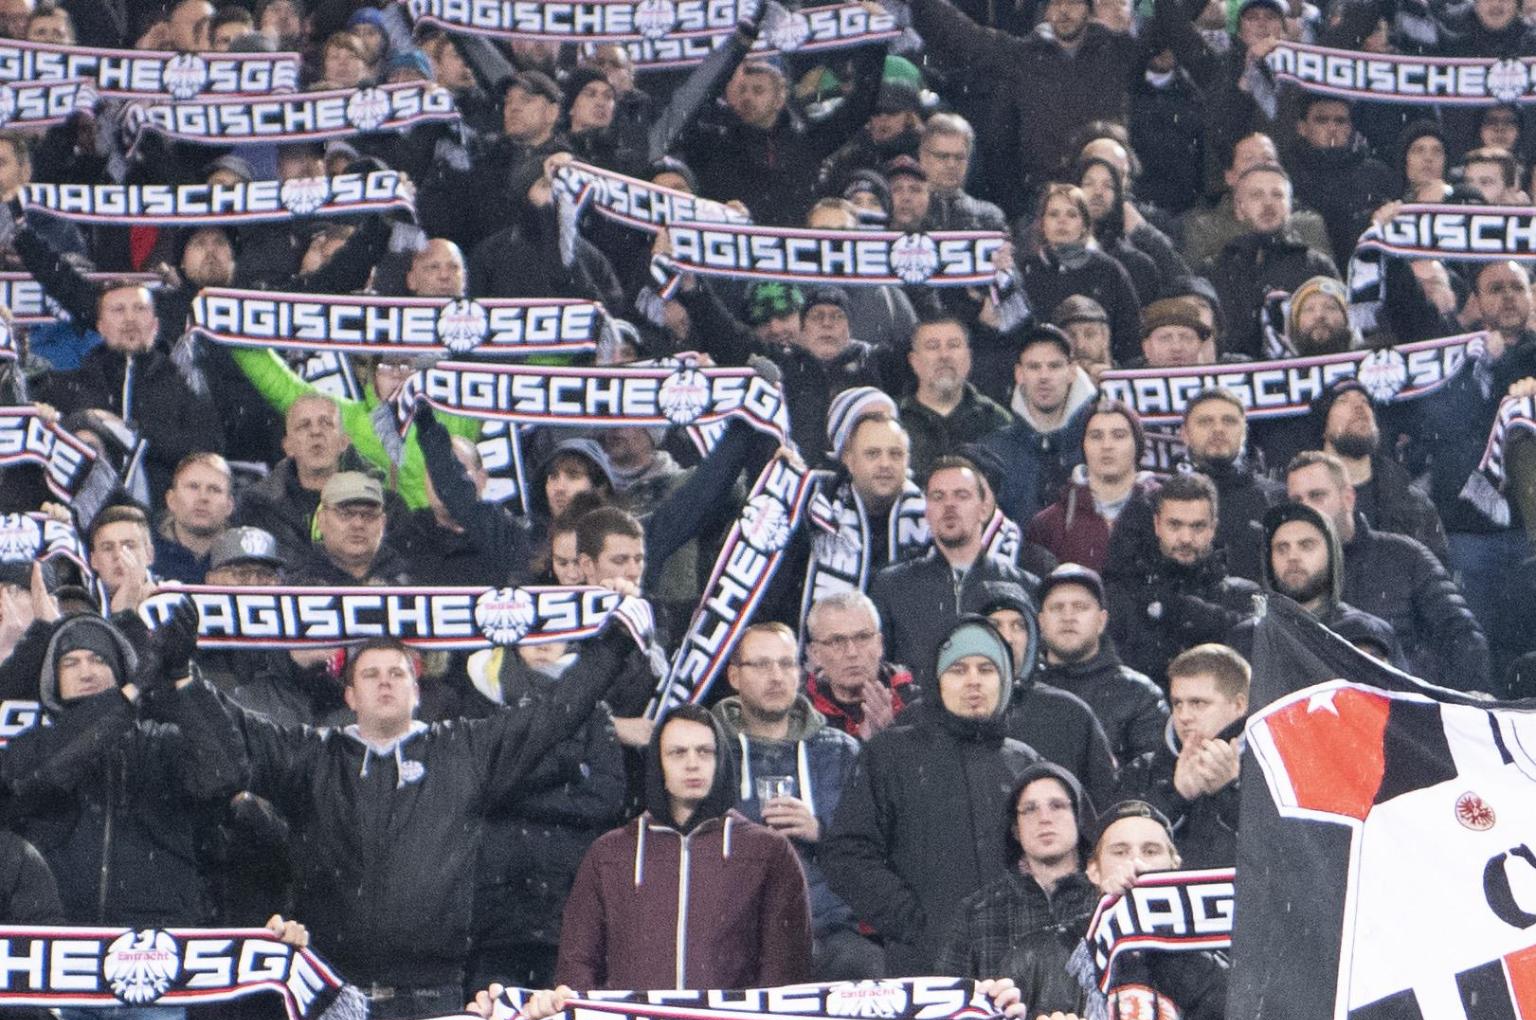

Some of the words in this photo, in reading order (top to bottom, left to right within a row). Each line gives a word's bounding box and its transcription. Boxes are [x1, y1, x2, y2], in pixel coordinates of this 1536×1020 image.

[1268, 45, 1486, 96] MAGISCHE
[490, 304, 594, 343] SGE
[117, 950, 170, 963] Eintracht
[183, 938, 327, 1017] SGE
[840, 986, 897, 999] Eintracht
